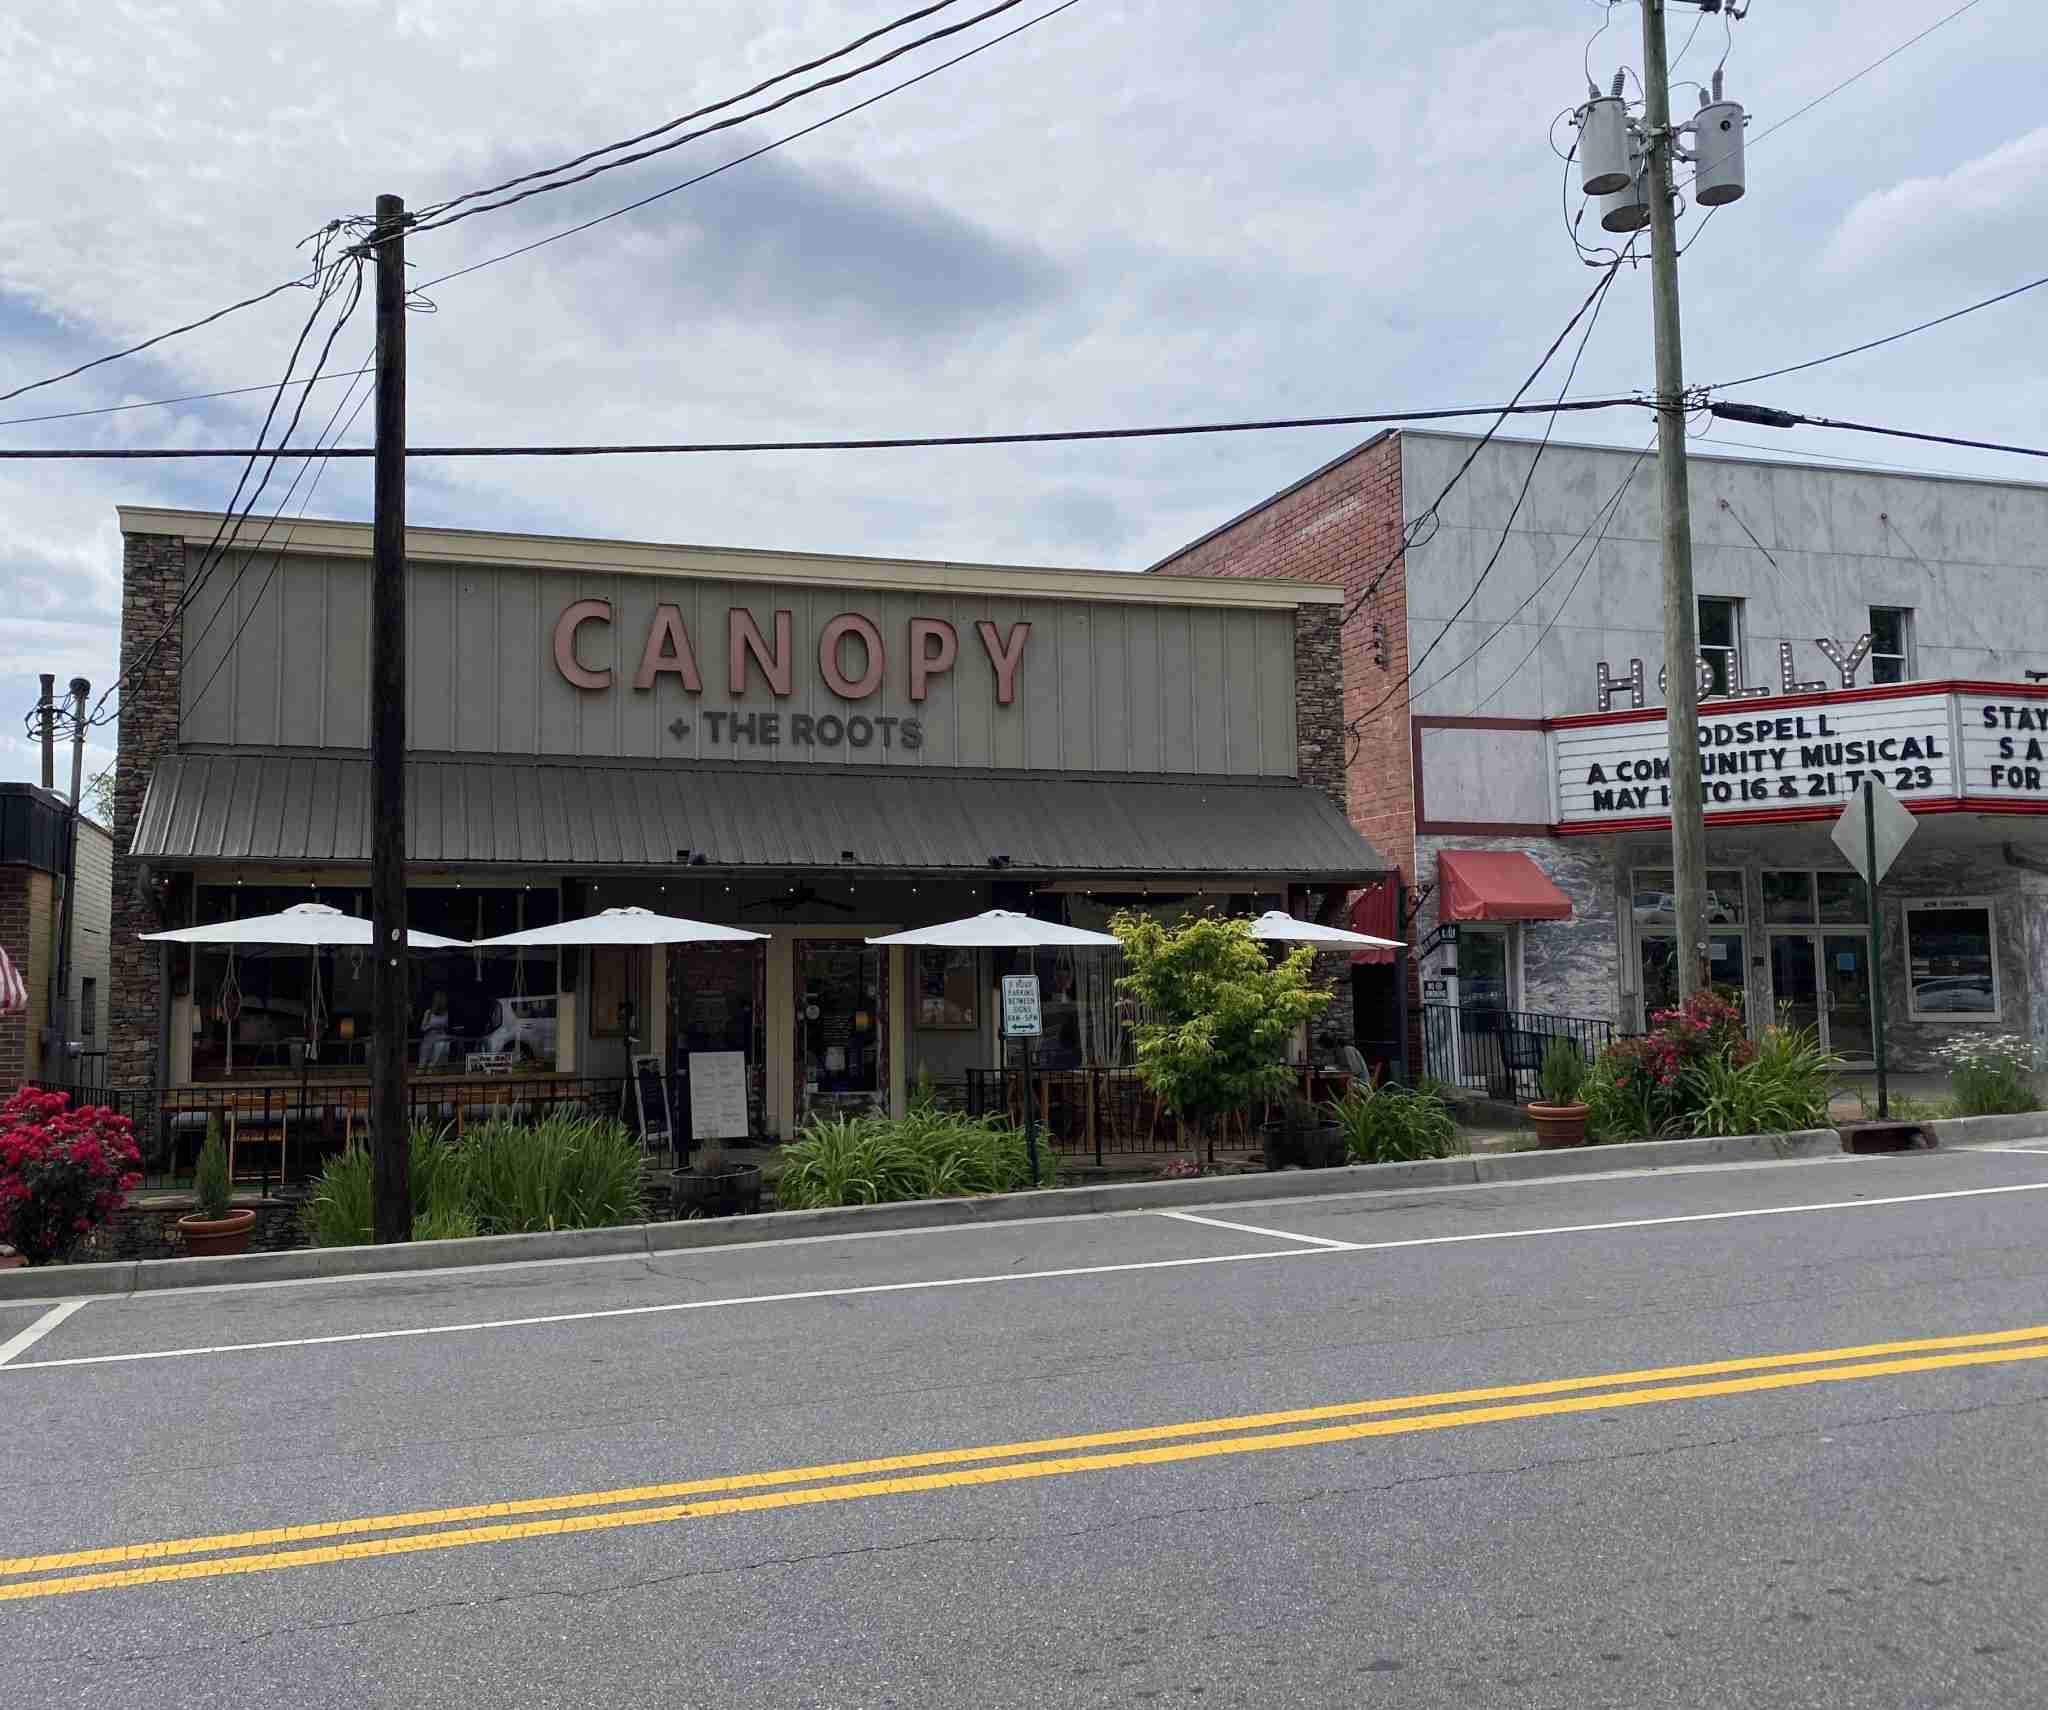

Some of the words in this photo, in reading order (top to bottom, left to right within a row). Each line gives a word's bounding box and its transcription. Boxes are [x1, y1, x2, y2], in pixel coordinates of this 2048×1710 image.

[552, 599, 1033, 705] CANOPY
[703, 711, 780, 745] THE
[791, 713, 922, 750] ROOTS
[1698, 714, 1835, 748] ODSPELL
[1983, 705, 2048, 731] STAY
[1587, 763, 1608, 785] A
[1616, 748, 1786, 781] COMUNITY
[1801, 735, 1943, 769] MUSICAL
[1991, 765, 2041, 790] FOR
[1593, 786, 1649, 811] MAY
[1741, 778, 1768, 801] 16
[1779, 776, 1798, 798] &
[1808, 773, 1836, 796] 21
[1896, 766, 1933, 790] 23
